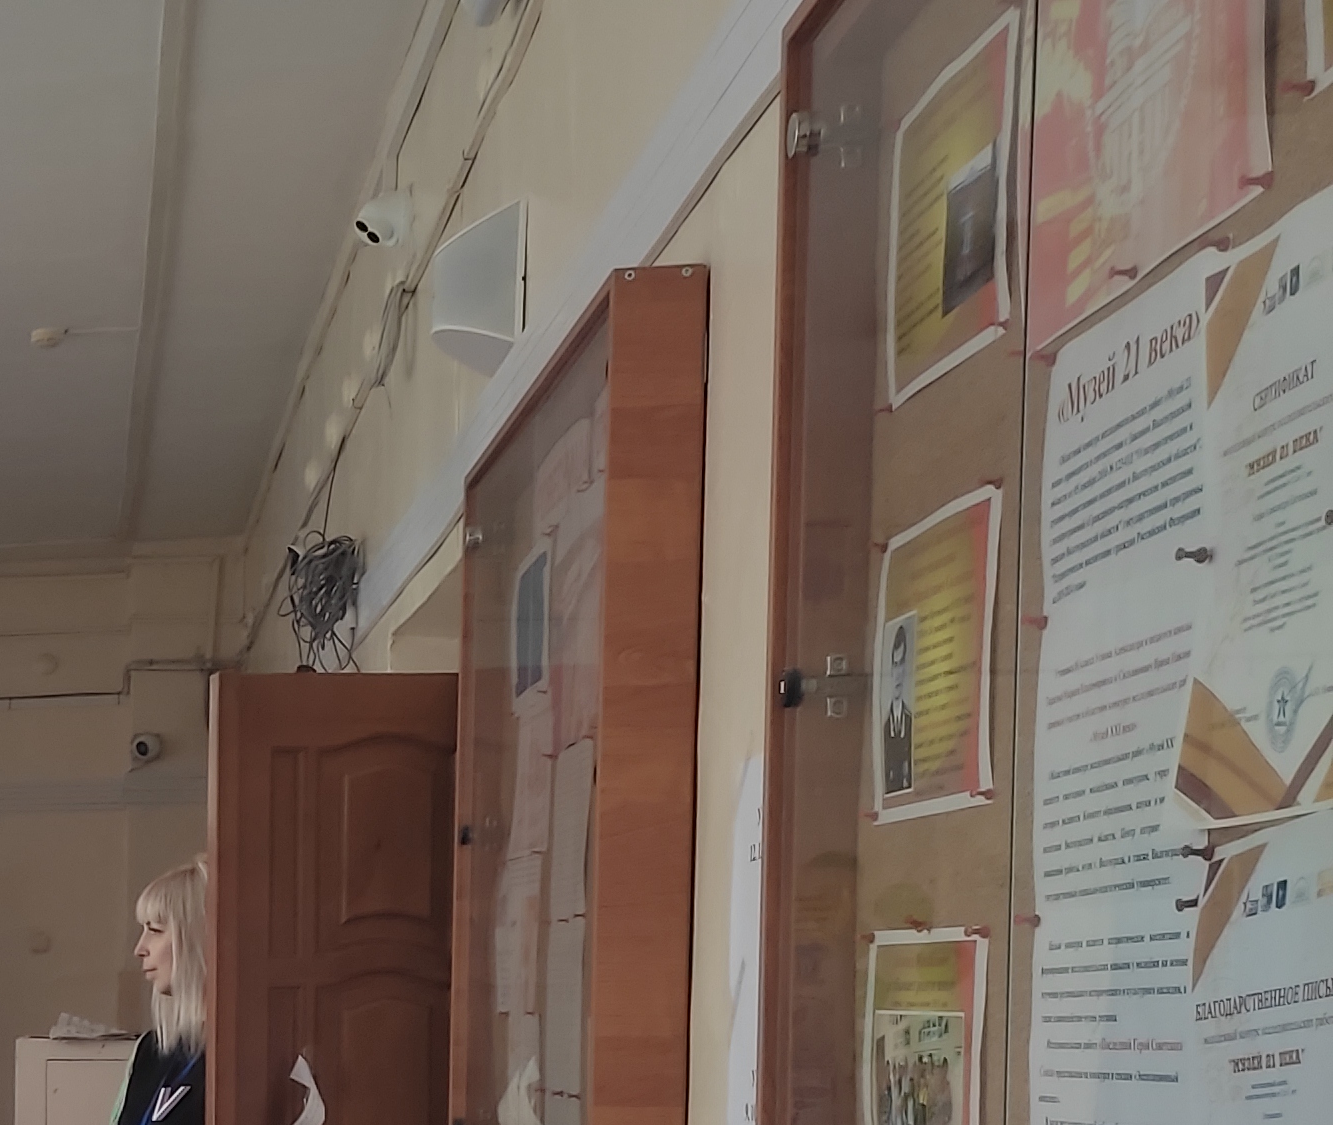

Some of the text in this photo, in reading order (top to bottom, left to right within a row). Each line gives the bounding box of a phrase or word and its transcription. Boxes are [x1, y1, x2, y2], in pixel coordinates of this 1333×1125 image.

[1058, 351, 1116, 424] «Музей
[1121, 334, 1141, 385] 21
[1195, 977, 1333, 1022] БЛАГОДАРСТВЕННОЕ ПИСЬ
